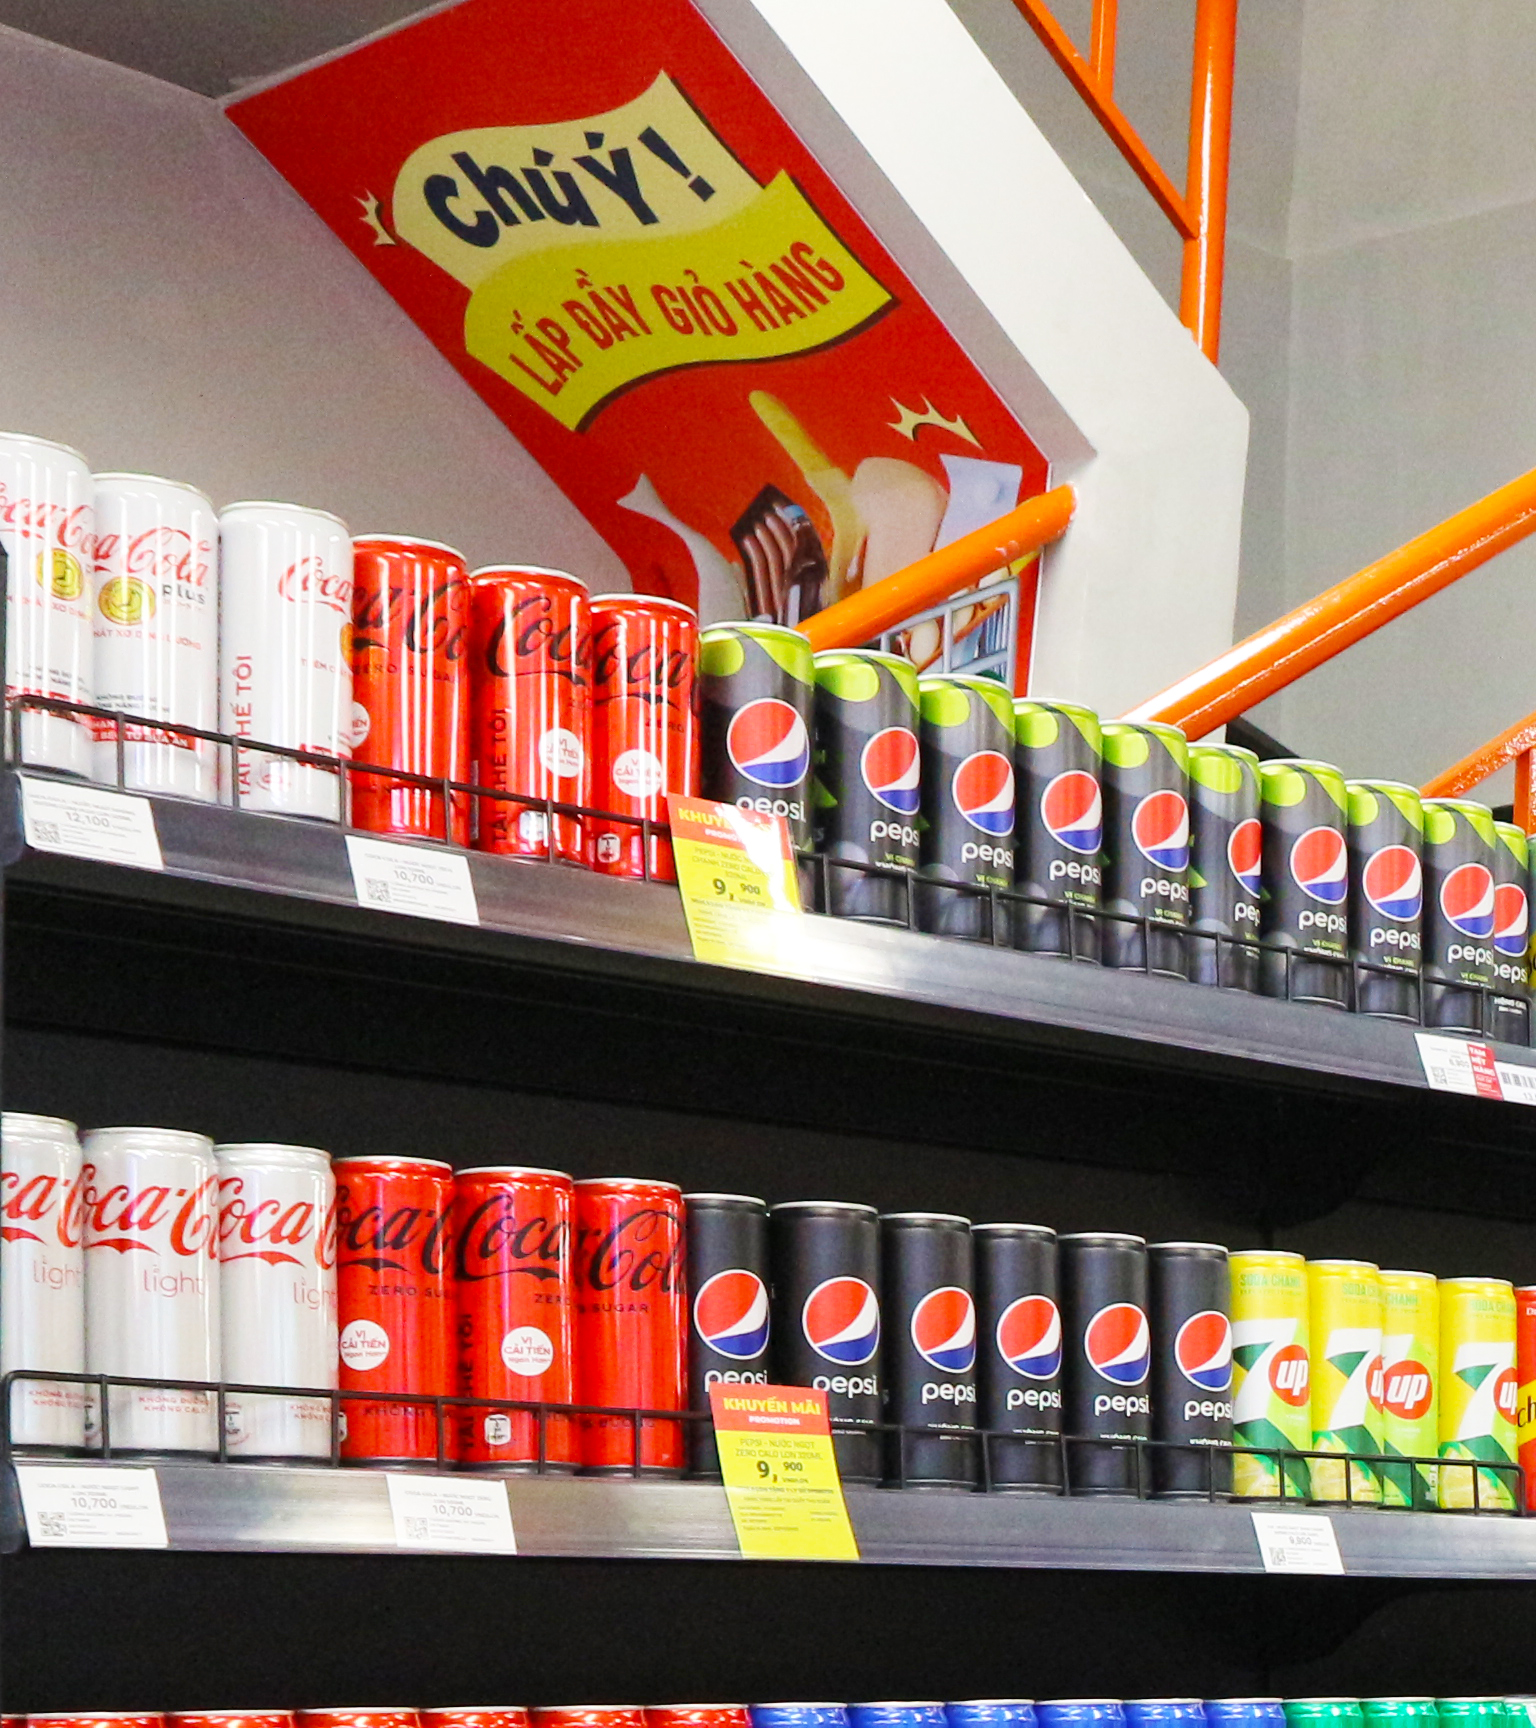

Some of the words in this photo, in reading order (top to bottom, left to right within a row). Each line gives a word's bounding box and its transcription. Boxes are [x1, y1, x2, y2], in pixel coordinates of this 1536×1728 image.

[509, 309, 585, 397] LẤP
[562, 268, 652, 352] ĐẦY
[650, 268, 739, 338] GIỎ
[724, 241, 846, 333] HÀNG
[65, 811, 110, 828] 12,100
[391, 867, 435, 887] 10,700
[812, 1372, 879, 1398] pepsi
[921, 1380, 976, 1405] pepsi
[1094, 1392, 1150, 1417] pepsi
[783, 1461, 803, 1471] 900
[70, 1496, 119, 1512] 10,700
[432, 1504, 473, 1518] 10,700
